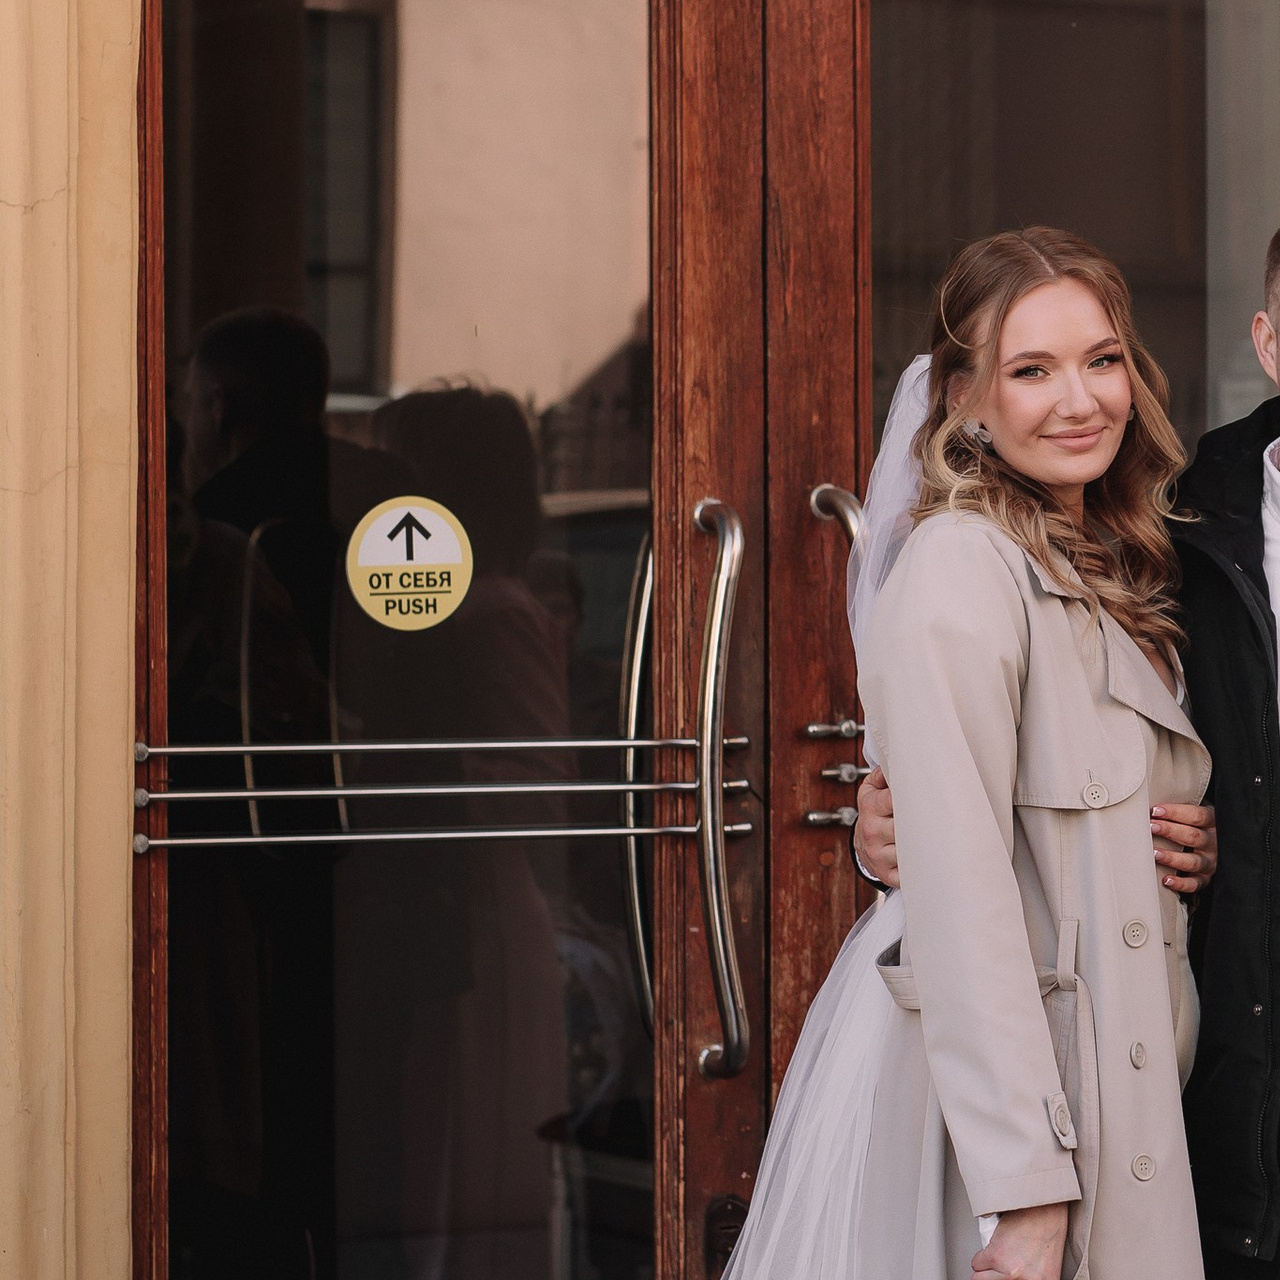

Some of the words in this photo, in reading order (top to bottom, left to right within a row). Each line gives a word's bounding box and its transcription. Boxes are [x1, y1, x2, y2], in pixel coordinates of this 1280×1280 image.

[368, 572, 393, 590] ОТ
[399, 571, 451, 588] СЕБЯ
[384, 597, 438, 616] PUSH
